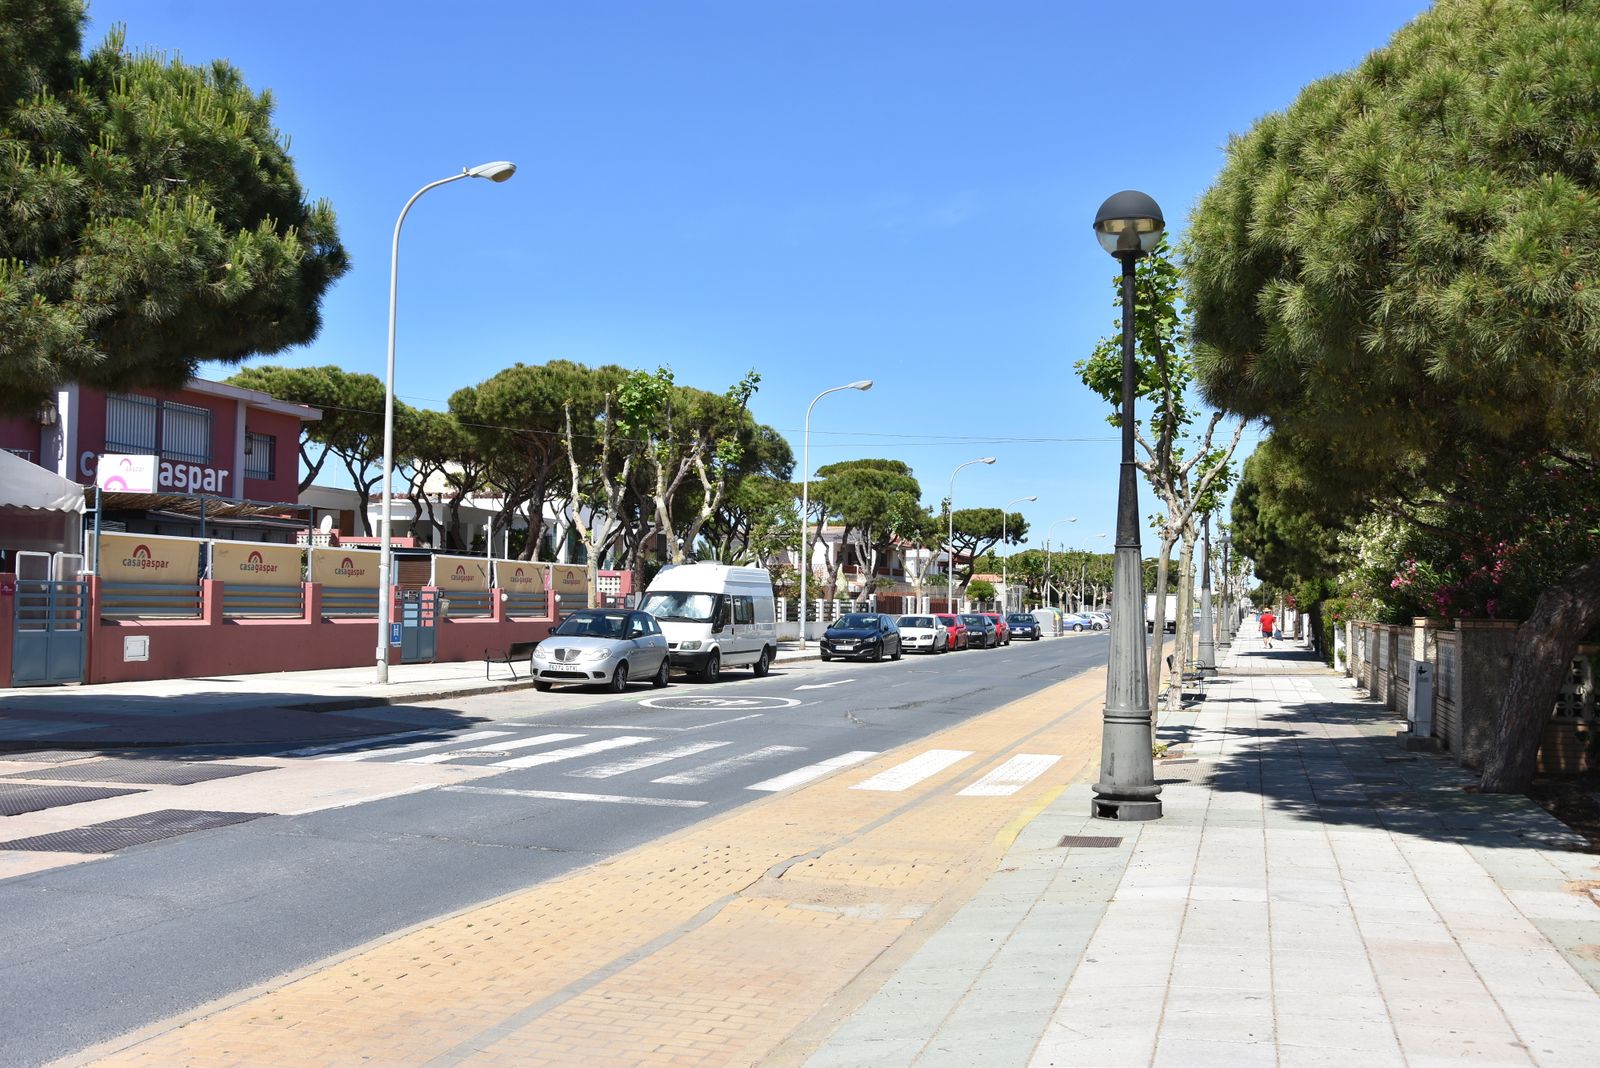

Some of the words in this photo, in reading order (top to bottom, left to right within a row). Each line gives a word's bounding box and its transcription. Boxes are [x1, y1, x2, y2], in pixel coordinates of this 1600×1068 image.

[122, 557, 169, 570] casagaspar
[239, 563, 278, 574] casagaspar
[334, 567, 365, 577] casagaspar
